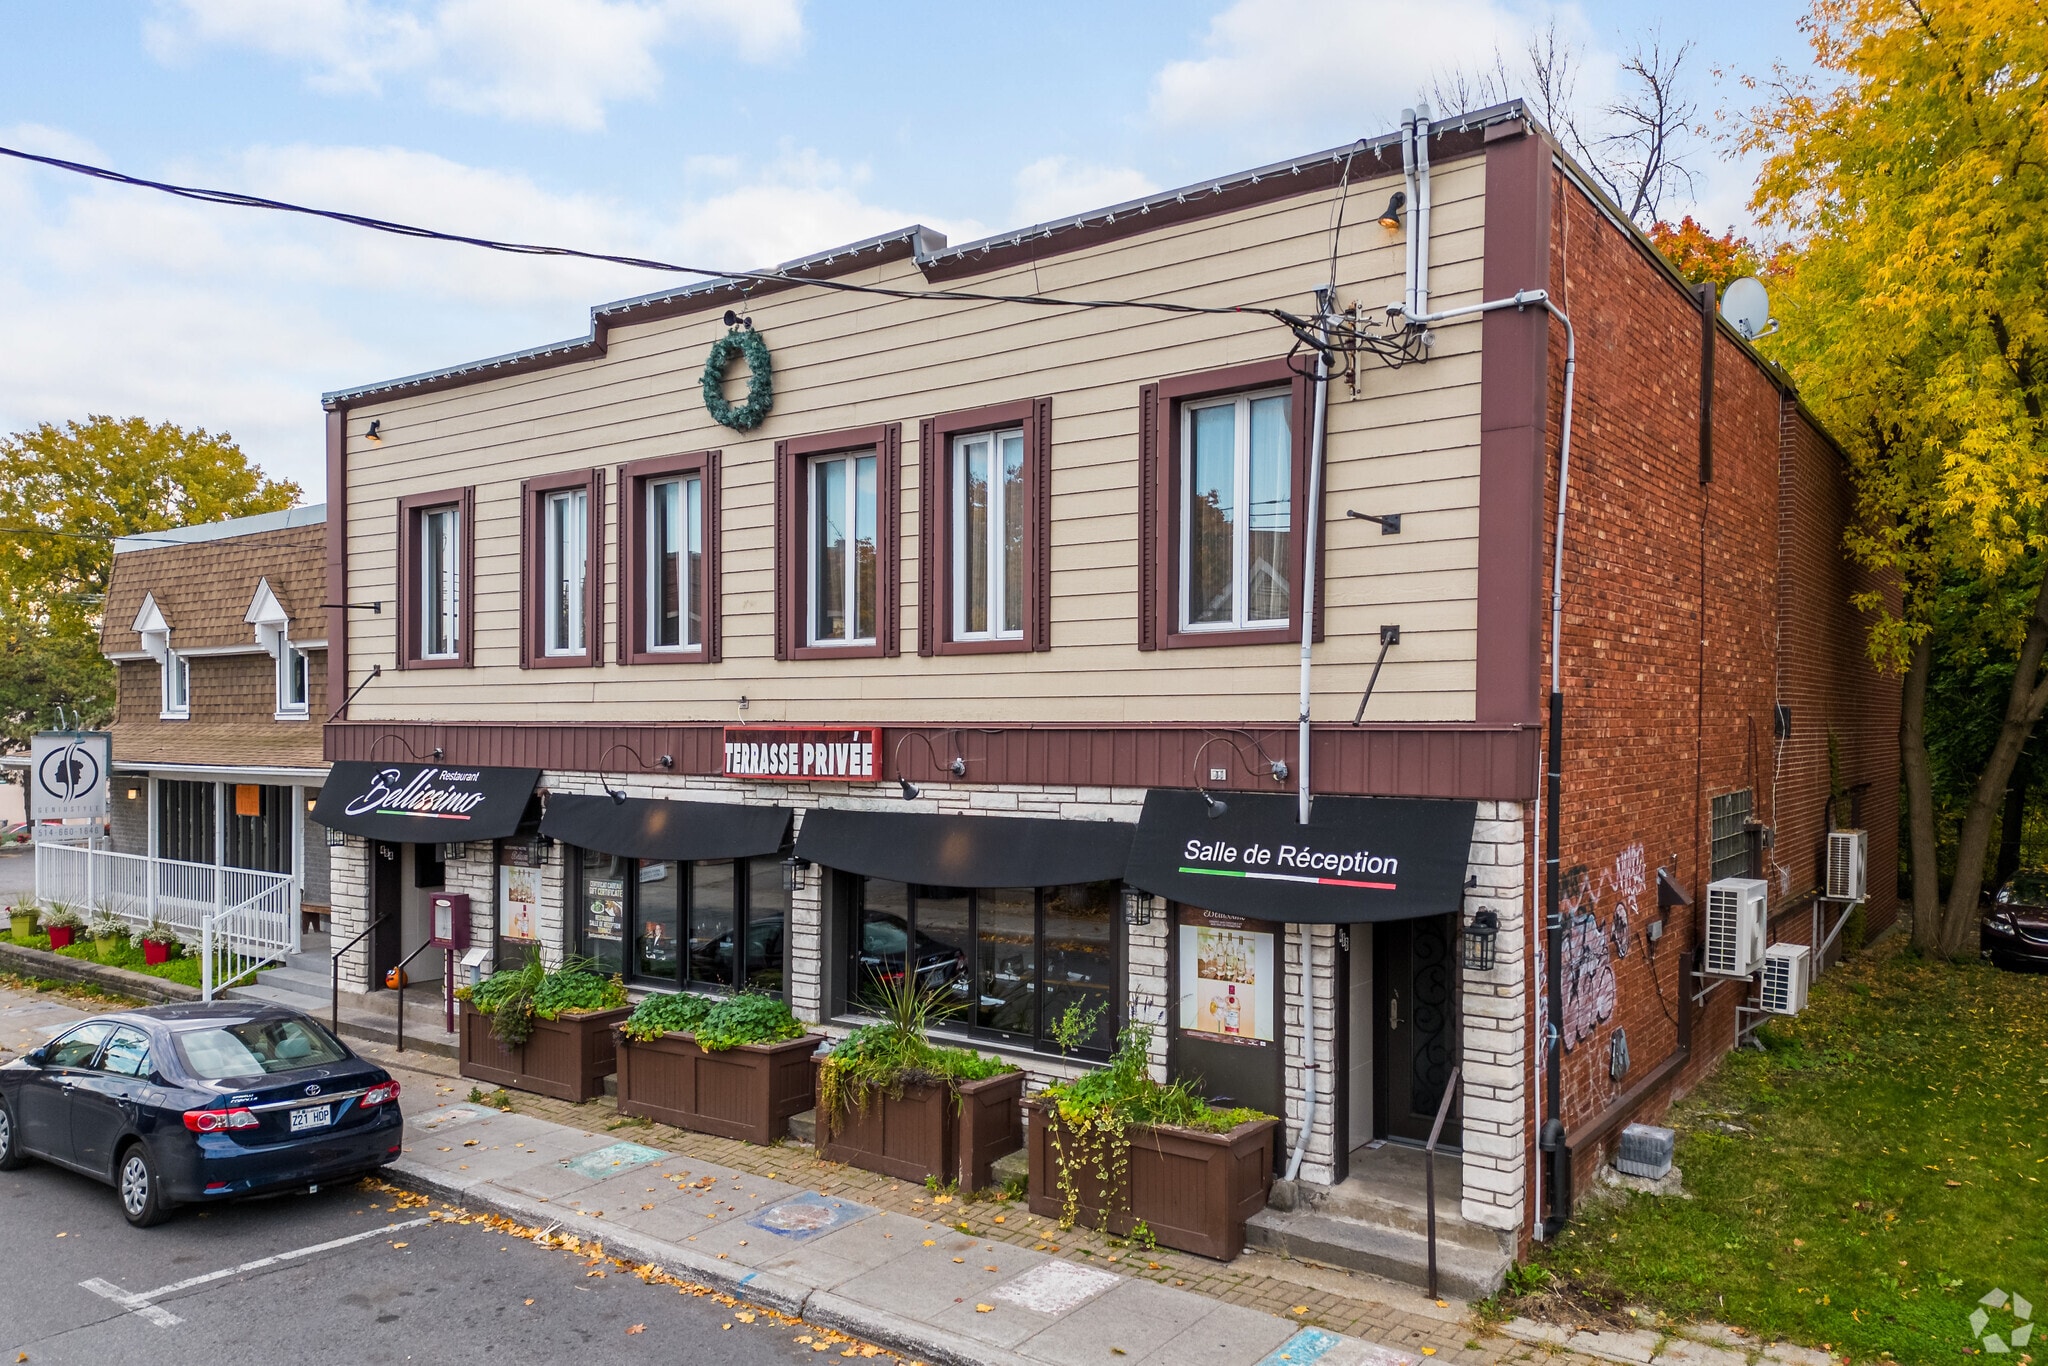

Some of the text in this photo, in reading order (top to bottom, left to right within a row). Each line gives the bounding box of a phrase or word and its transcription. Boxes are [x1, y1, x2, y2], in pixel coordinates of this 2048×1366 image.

[725, 730, 872, 775] TERRASSE PRIVÉE
[345, 768, 486, 816] Bellissimo
[439, 770, 480, 782] Restaurant
[1184, 839, 1398, 876] Salle de Réception
[292, 1113, 308, 1127] Z21
